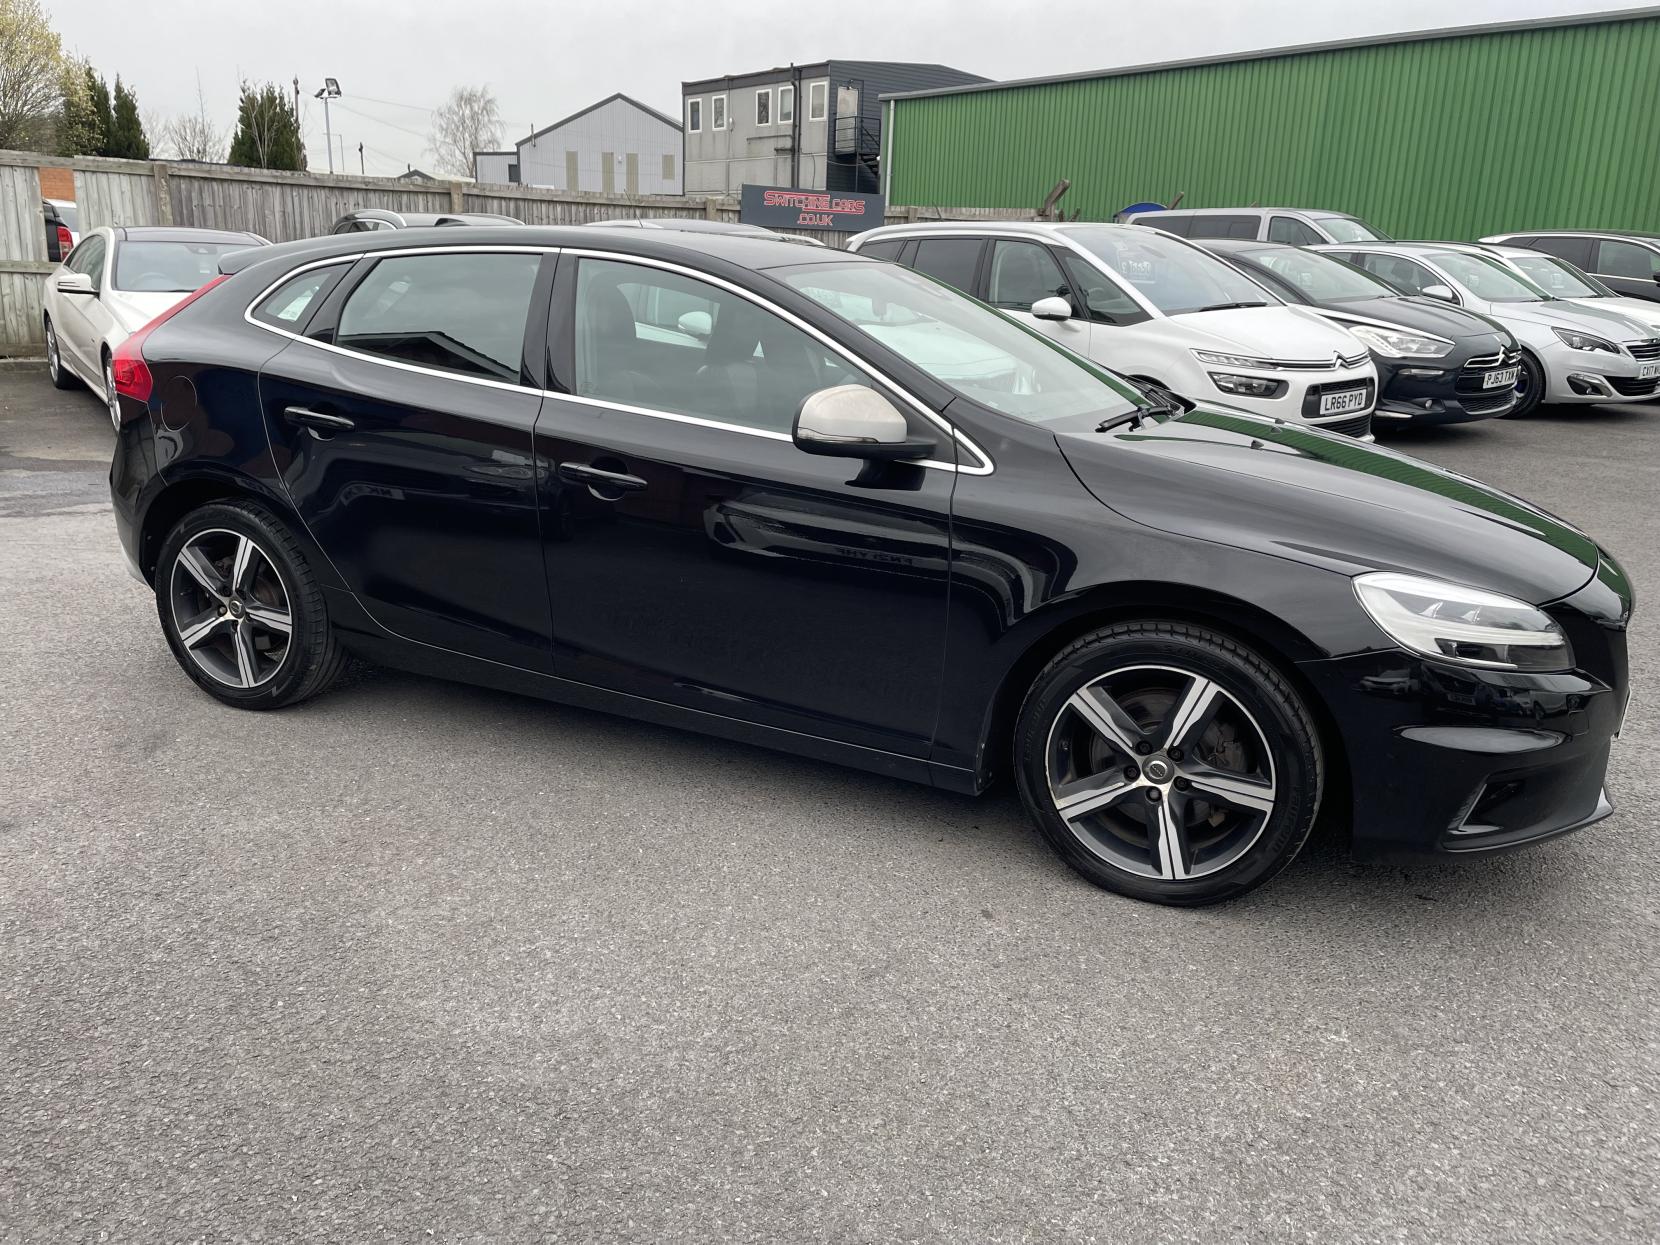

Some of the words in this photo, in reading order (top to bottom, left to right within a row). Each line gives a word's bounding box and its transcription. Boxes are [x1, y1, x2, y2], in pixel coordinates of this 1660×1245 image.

[764, 191, 830, 209] SWITCHING
[832, 199, 865, 214] CARS
[1486, 371, 1504, 386] PJ63
[1325, 396, 1347, 411] LR66
[1347, 392, 1363, 408] PYD
